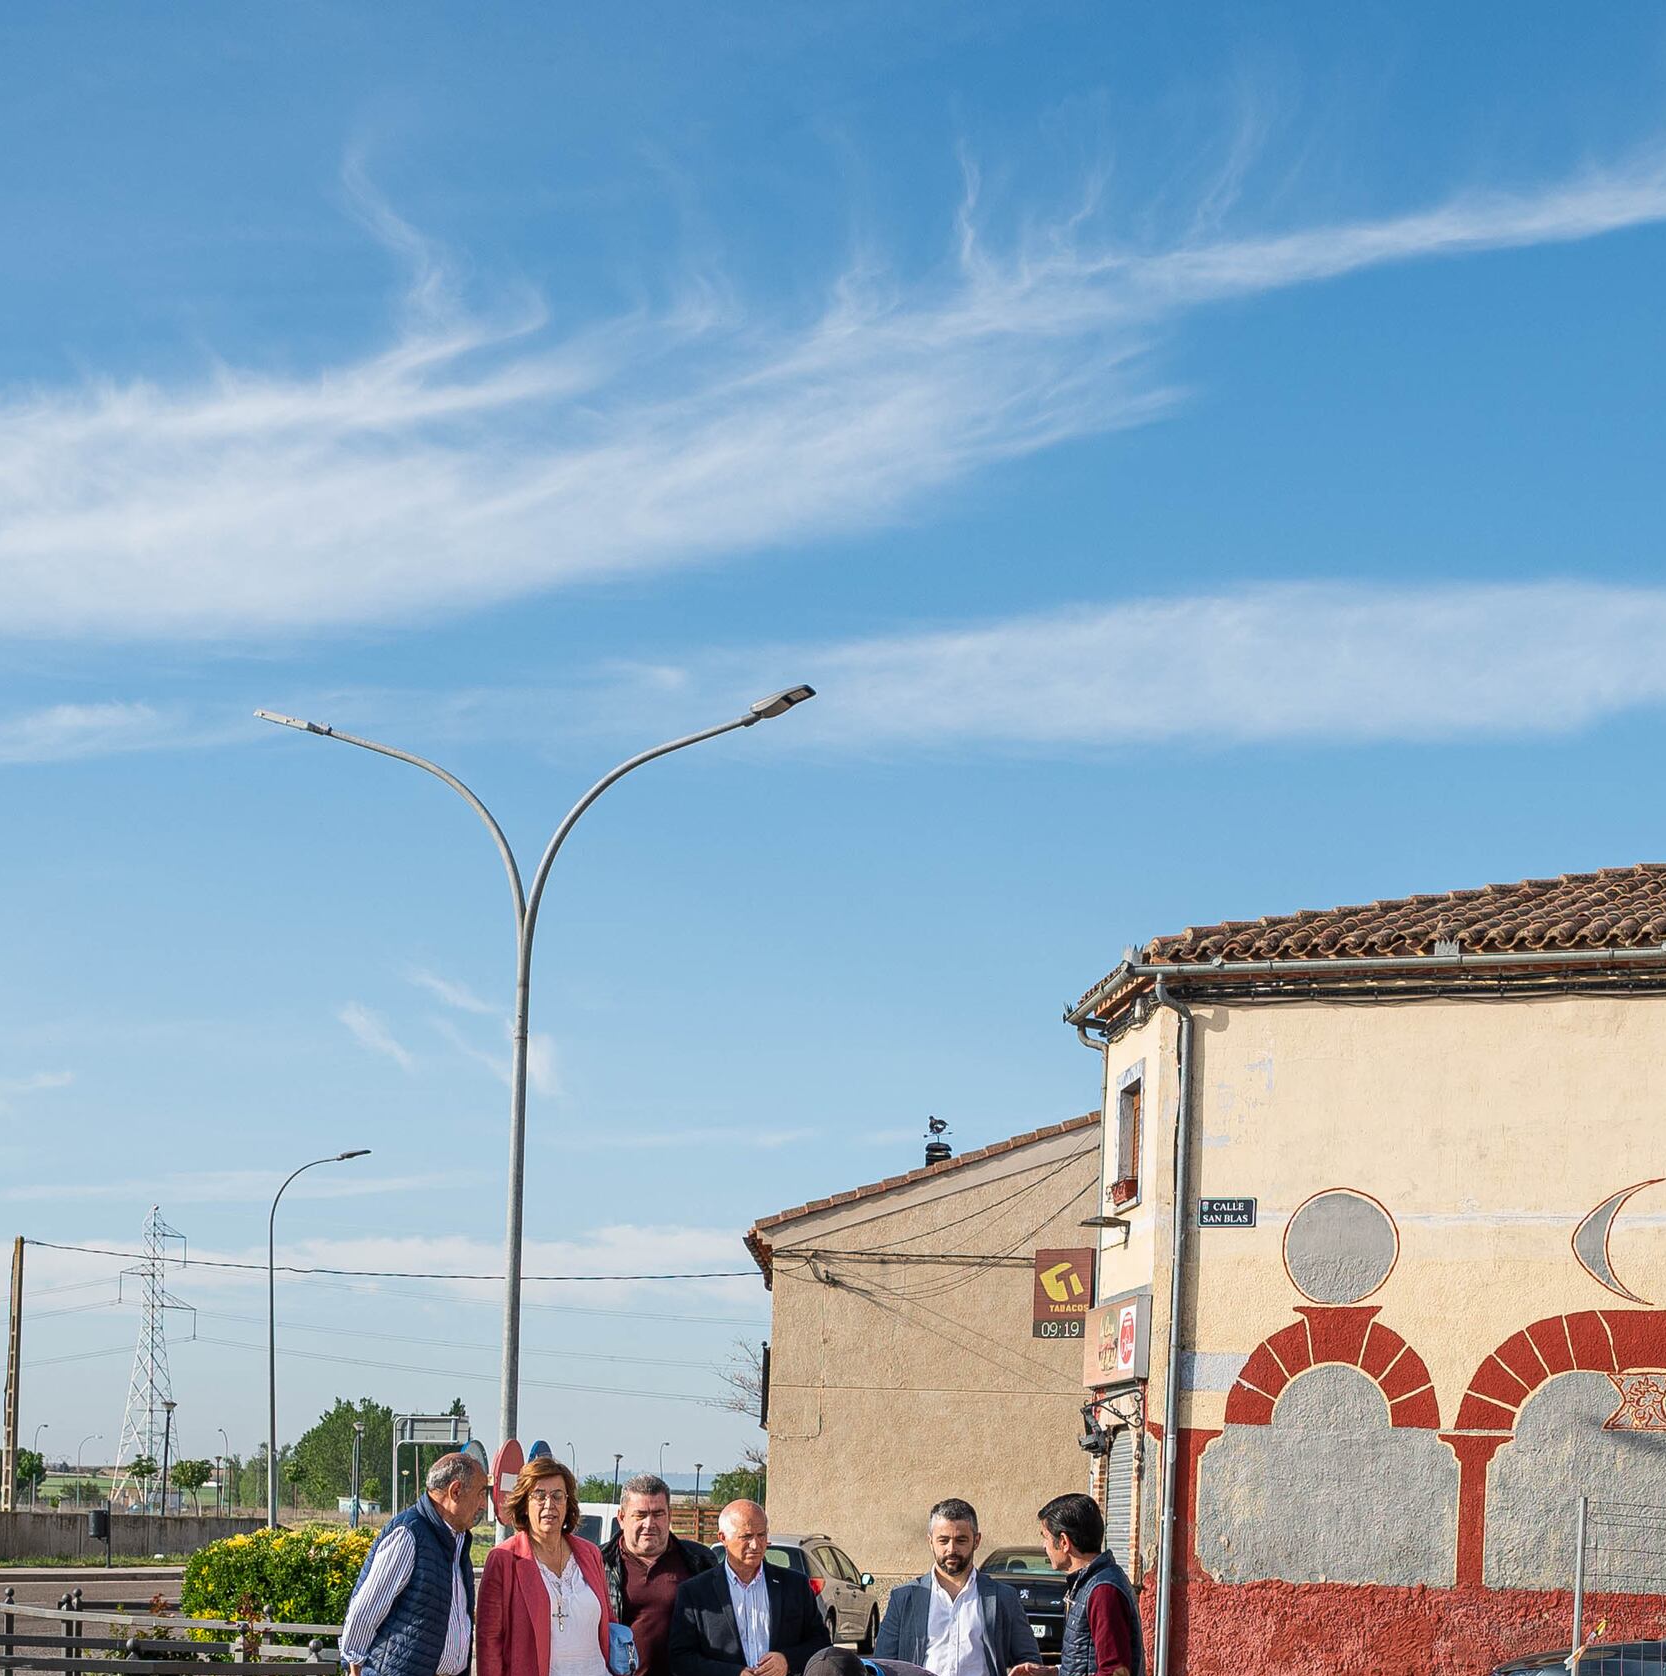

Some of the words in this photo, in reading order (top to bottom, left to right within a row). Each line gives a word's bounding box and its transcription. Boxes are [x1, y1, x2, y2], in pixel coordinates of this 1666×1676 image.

[1213, 1202, 1245, 1211] CALLE
[1203, 1214, 1222, 1223] SAN
[1224, 1214, 1249, 1223] BLAS
[1049, 1304, 1089, 1313] TABACOS
[1041, 1322, 1080, 1337] 09:19
